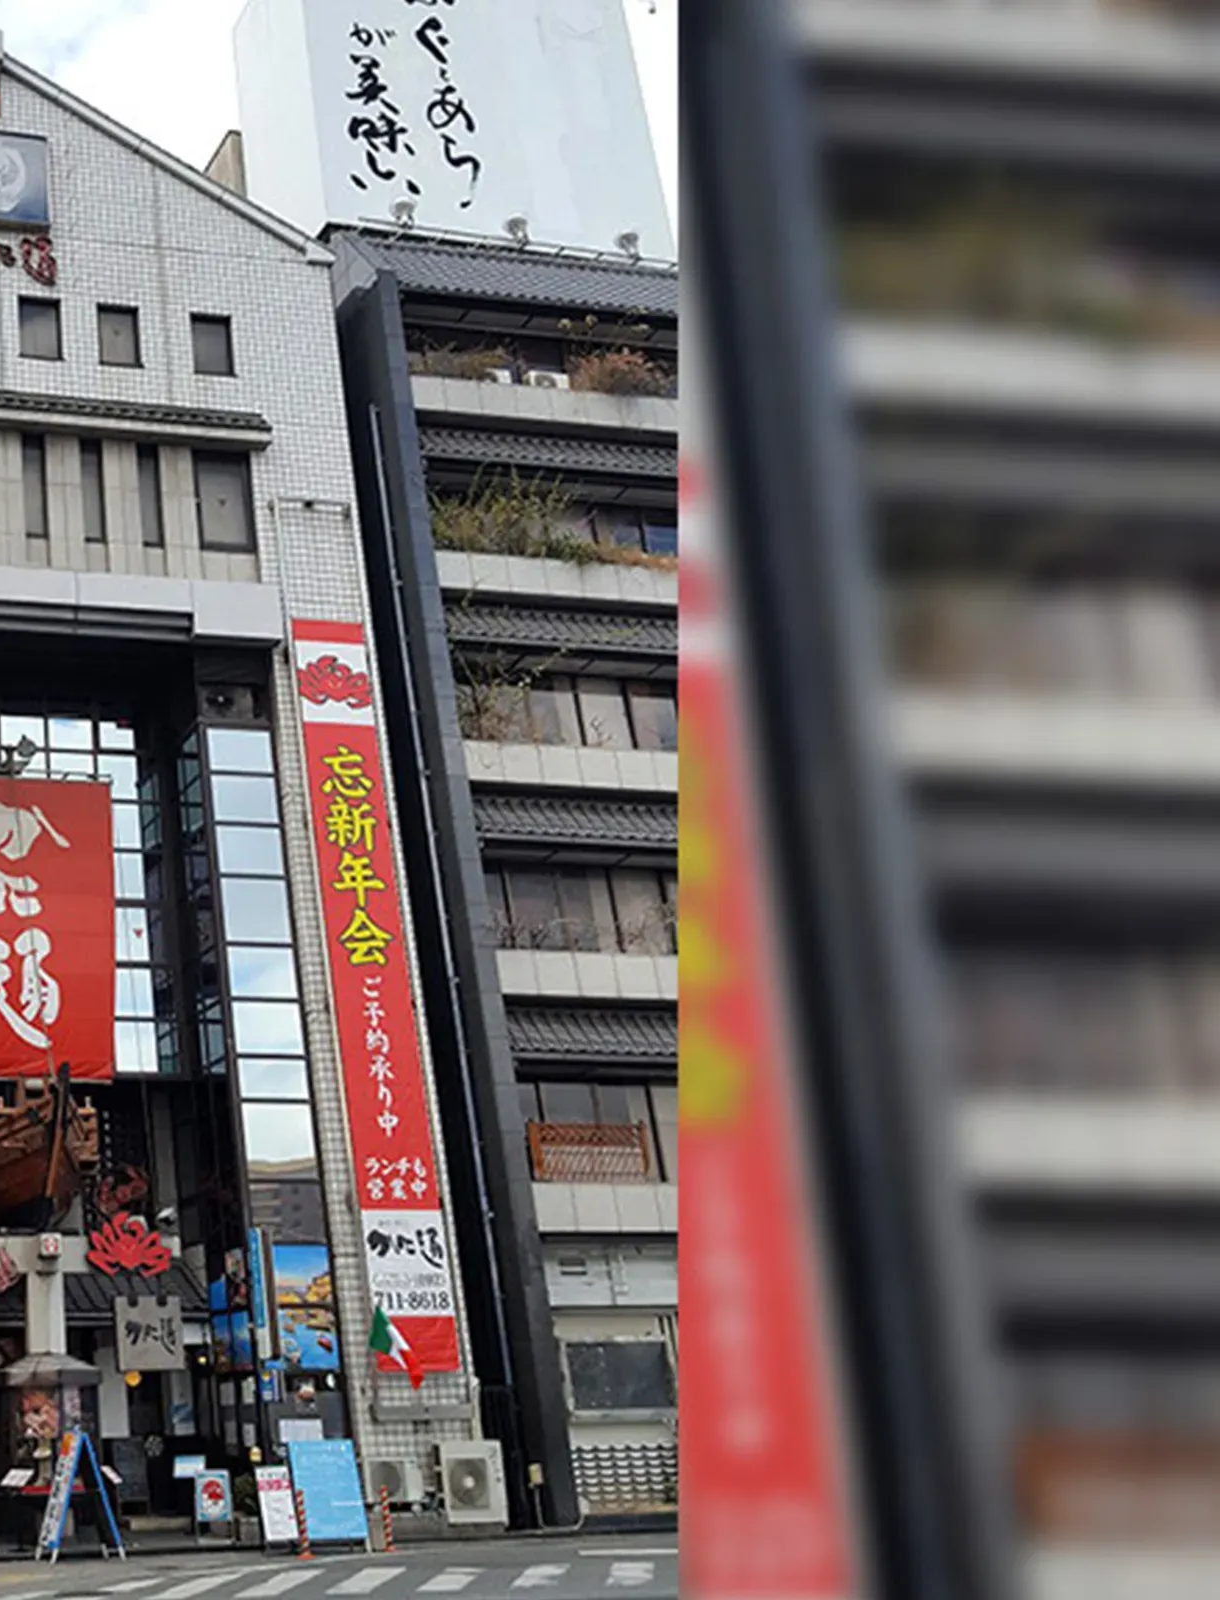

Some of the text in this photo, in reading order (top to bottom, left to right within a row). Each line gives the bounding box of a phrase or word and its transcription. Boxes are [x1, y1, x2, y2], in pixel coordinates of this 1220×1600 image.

[321, 745, 394, 966] 忘新年会
[362, 975, 400, 1138] ご予約承り中
[364, 1156, 427, 1178] ランチも
[366, 1177, 428, 1200] 営業中
[374, 1291, 450, 1311] 711-8618
